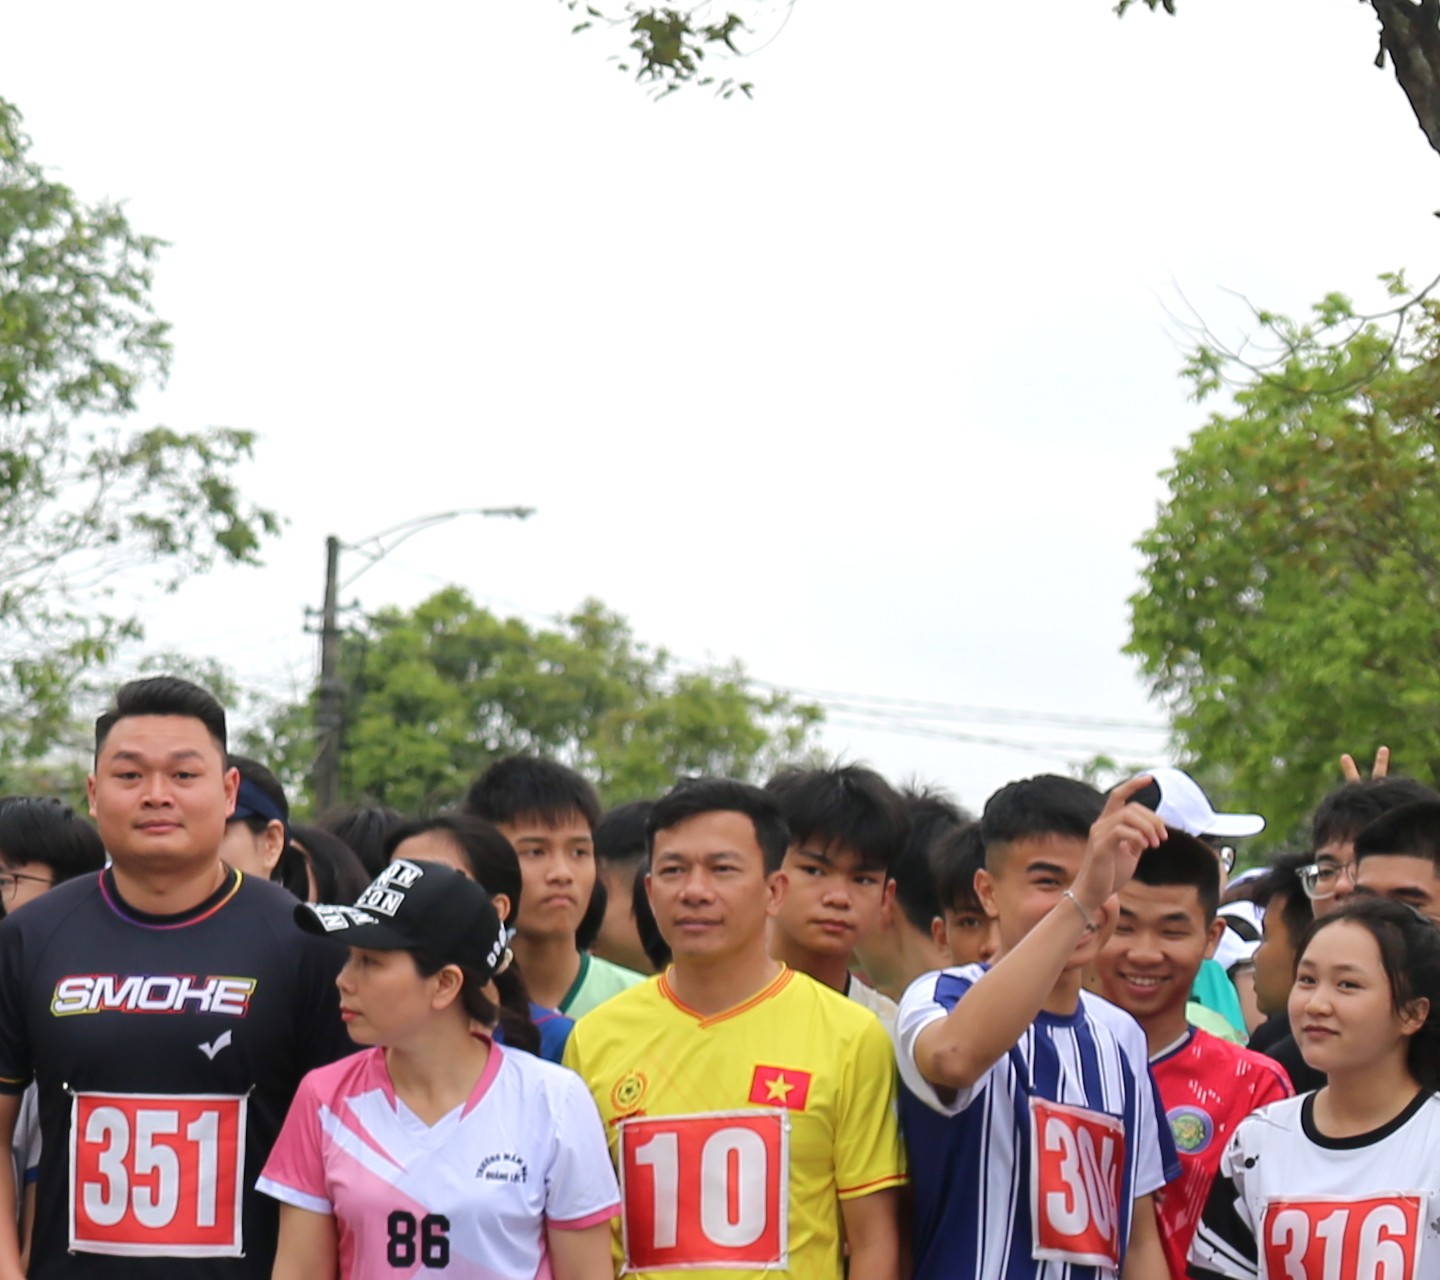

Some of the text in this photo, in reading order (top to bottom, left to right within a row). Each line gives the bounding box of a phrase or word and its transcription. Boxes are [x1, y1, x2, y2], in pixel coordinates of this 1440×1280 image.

[52, 974, 255, 1016] SMOKE
[83, 1106, 220, 1228] 351
[635, 1127, 767, 1249] 10
[387, 1210, 450, 1268] 86
